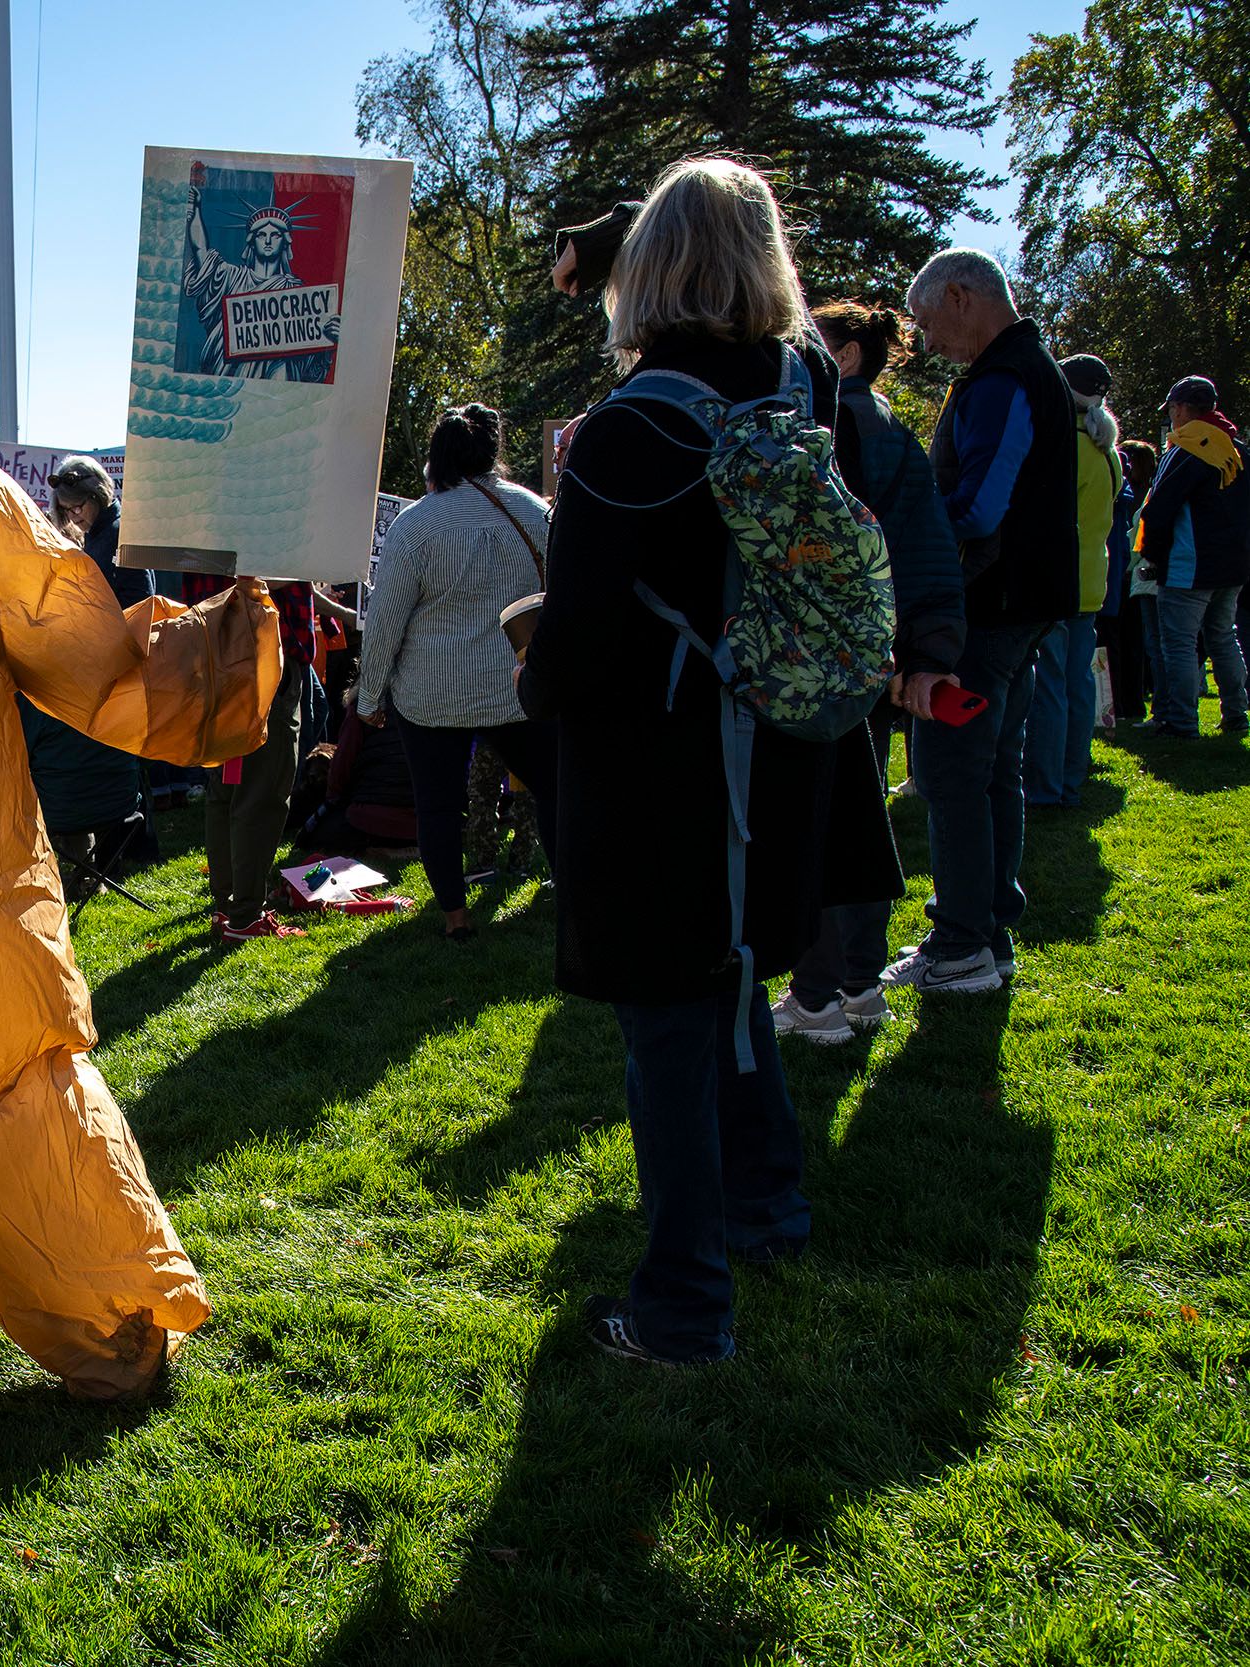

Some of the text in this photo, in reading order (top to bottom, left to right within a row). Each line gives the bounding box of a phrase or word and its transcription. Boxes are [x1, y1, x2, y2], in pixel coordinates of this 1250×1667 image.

[232, 290, 330, 325] DEMOCRACY
[235, 316, 322, 350] HAS NO KINGS
